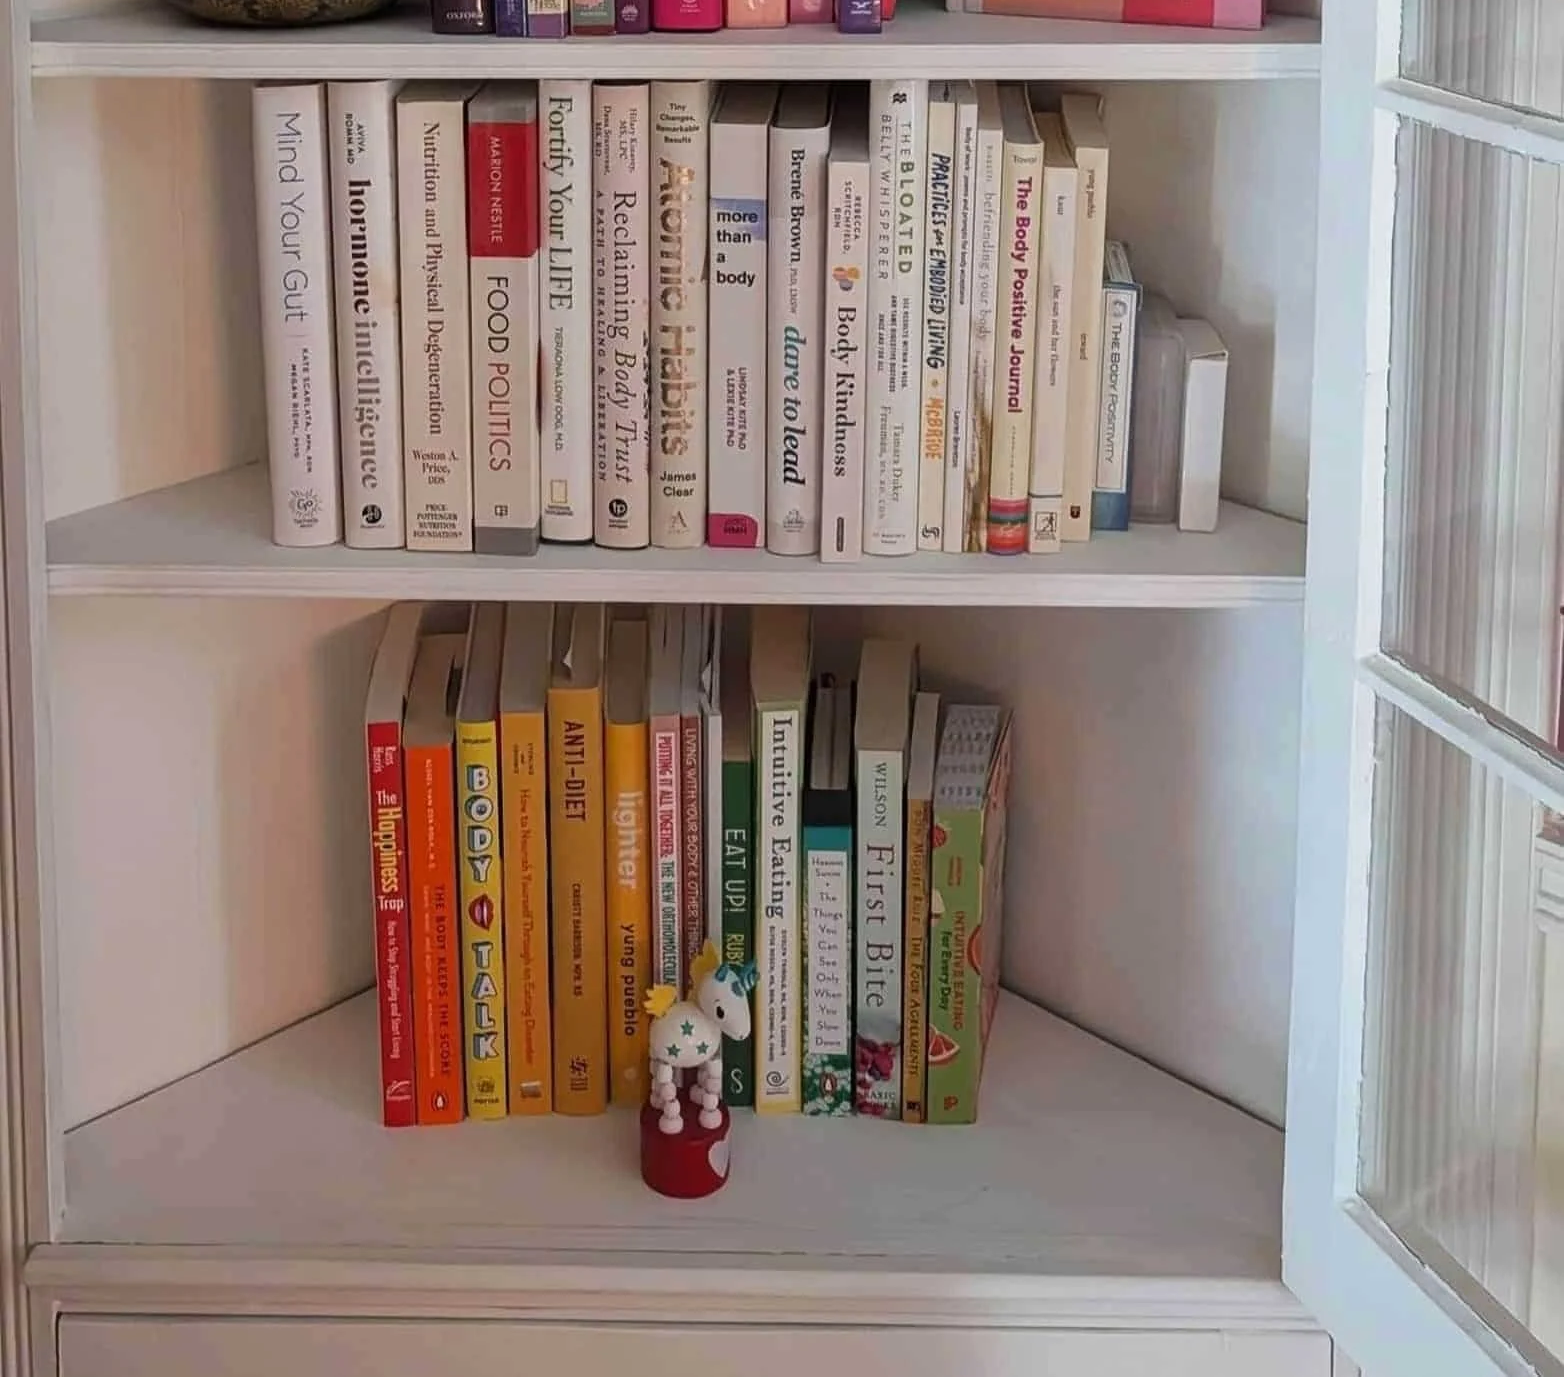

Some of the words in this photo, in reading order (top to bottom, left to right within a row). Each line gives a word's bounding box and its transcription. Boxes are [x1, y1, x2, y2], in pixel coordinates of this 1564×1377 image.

[277, 113, 304, 183] Mind
[423, 122, 440, 202] Nutrition
[489, 136, 503, 192] MARION
[543, 95, 574, 177] Fortify
[880, 114, 891, 162] BELLY
[900, 121, 912, 156] THE
[790, 149, 805, 200] Brené
[1017, 176, 1033, 211] The
[280, 192, 305, 261] Your
[424, 208, 440, 237] and
[490, 196, 503, 243] NESTLE
[549, 183, 573, 241] Your
[660, 157, 695, 311] Atomic
[716, 211, 758, 223] more
[716, 230, 752, 244] than
[790, 205, 805, 263] Brown
[878, 170, 889, 279] WHISPERER
[899, 162, 914, 274] BLOATED
[1011, 216, 1030, 263] Body
[348, 179, 372, 314] hormone
[422, 243, 444, 312] Physical
[548, 246, 573, 311] LIFE
[607, 191, 637, 340] Reclaiming
[716, 253, 726, 263] a
[716, 270, 755, 287] body
[283, 269, 309, 322] Gut
[487, 276, 509, 353] FOOD
[1011, 268, 1029, 338] Positive
[783, 326, 806, 390] dare
[830, 306, 858, 364] Body
[354, 321, 382, 489] intelligence
[424, 319, 444, 435] Degeneration
[606, 349, 637, 409] Body
[660, 324, 696, 456] Habits
[784, 397, 801, 421] to
[1007, 343, 1025, 413] Journal
[488, 363, 511, 472] POLITICS
[834, 372, 856, 477] Kindness
[614, 420, 637, 484] Trust
[783, 425, 806, 485] lead
[376, 790, 397, 806] The
[563, 721, 586, 822] ANTI-DIET
[772, 718, 792, 826] Intuitive
[373, 807, 403, 893] Happiness
[465, 765, 494, 883] BODY
[613, 791, 643, 890] lighter
[725, 828, 746, 869] EAT
[377, 895, 404, 913] Trap
[725, 880, 746, 912] UP!
[766, 836, 792, 919] Eating
[866, 844, 895, 926] First
[620, 923, 637, 967] yung
[726, 933, 745, 967] RUBY
[938, 950, 953, 985] Every
[941, 931, 952, 949] for
[953, 910, 966, 980] INTUITIVE
[471, 941, 499, 1060] TALK
[621, 975, 639, 1036] pueblo
[866, 941, 894, 1008] Bite
[938, 987, 952, 1011] Day
[952, 981, 965, 1031] EATING
